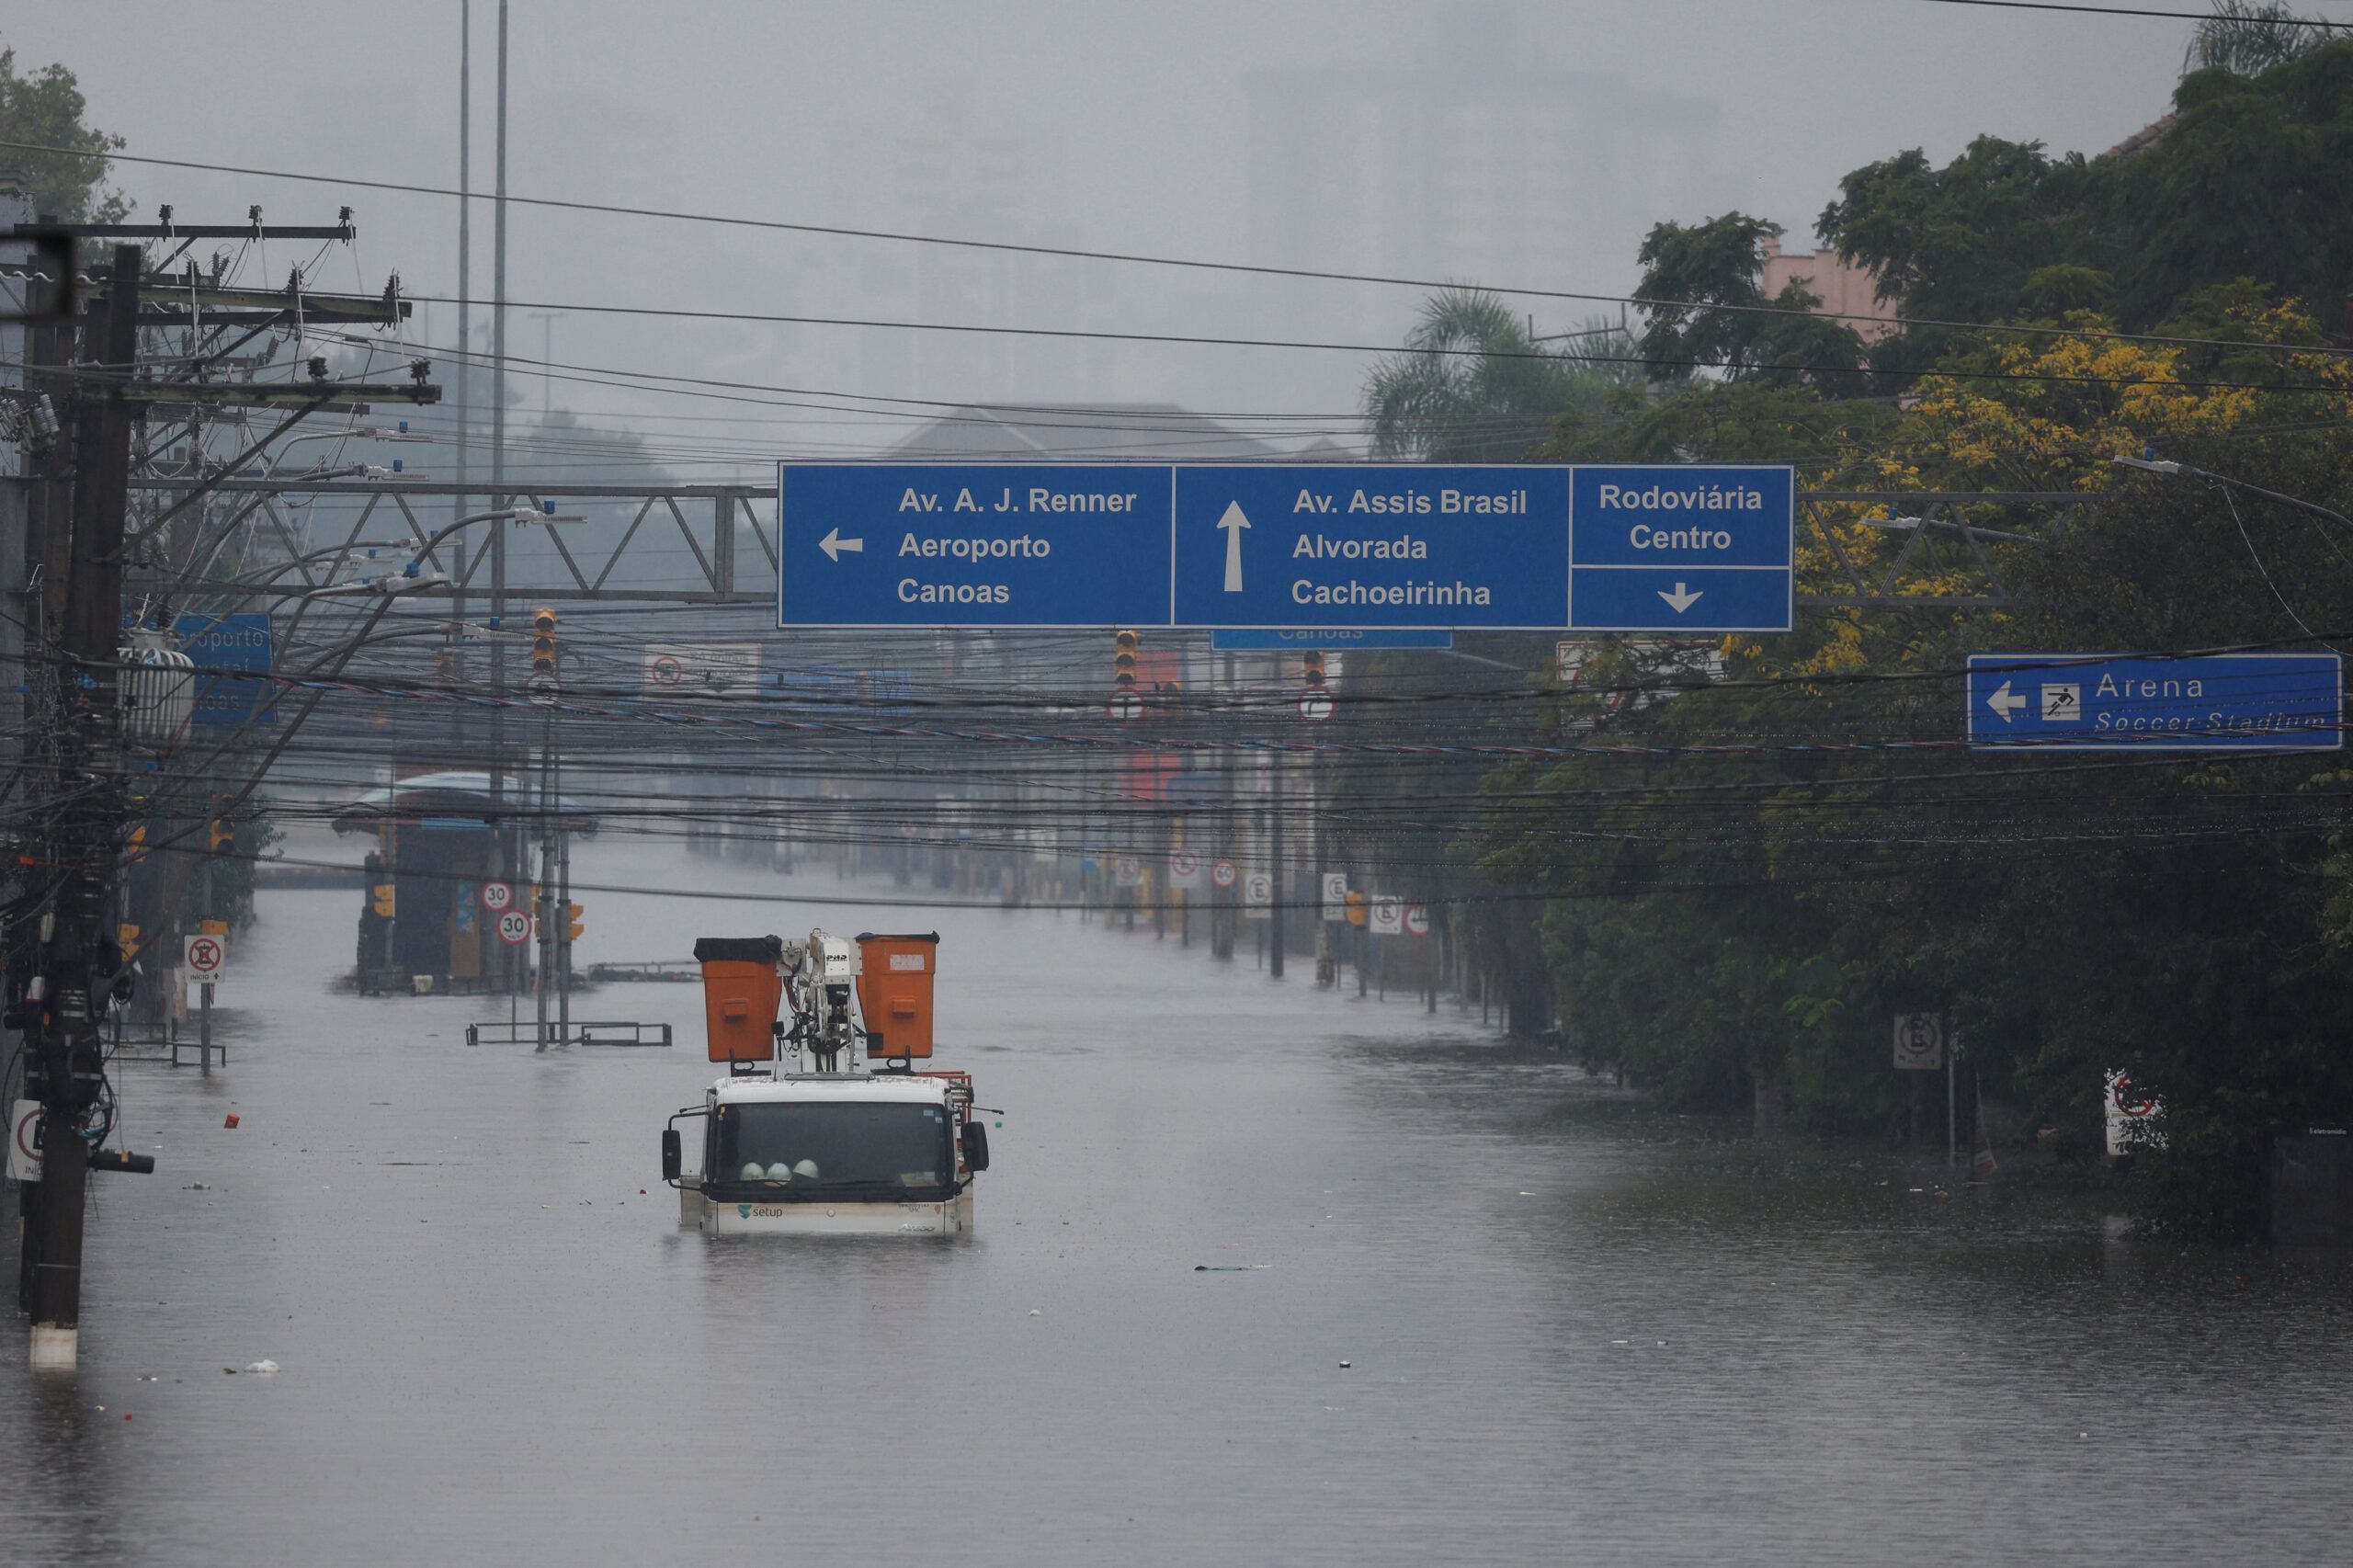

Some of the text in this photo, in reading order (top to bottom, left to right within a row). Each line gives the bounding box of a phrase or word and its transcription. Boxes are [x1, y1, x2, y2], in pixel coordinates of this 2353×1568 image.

[899, 488, 1137, 512] Av. A. J. Renner
[1293, 489, 1527, 515] Av. Assis Brasil
[1600, 485, 1762, 509] Rodoviária
[899, 533, 1051, 562] Aeroporto
[1293, 534, 1427, 559] Alvorada
[1631, 525, 1732, 550] Centro
[898, 578, 1010, 604] Canoas
[1292, 580, 1491, 605] Cachoeirinha
[176, 631, 263, 651] eroporto
[2096, 674, 2202, 698] Arena
[2095, 712, 2325, 732] Soccer Stadium
[488, 888, 506, 900] 30
[504, 917, 524, 932] 30
[753, 1207, 783, 1219] setup
